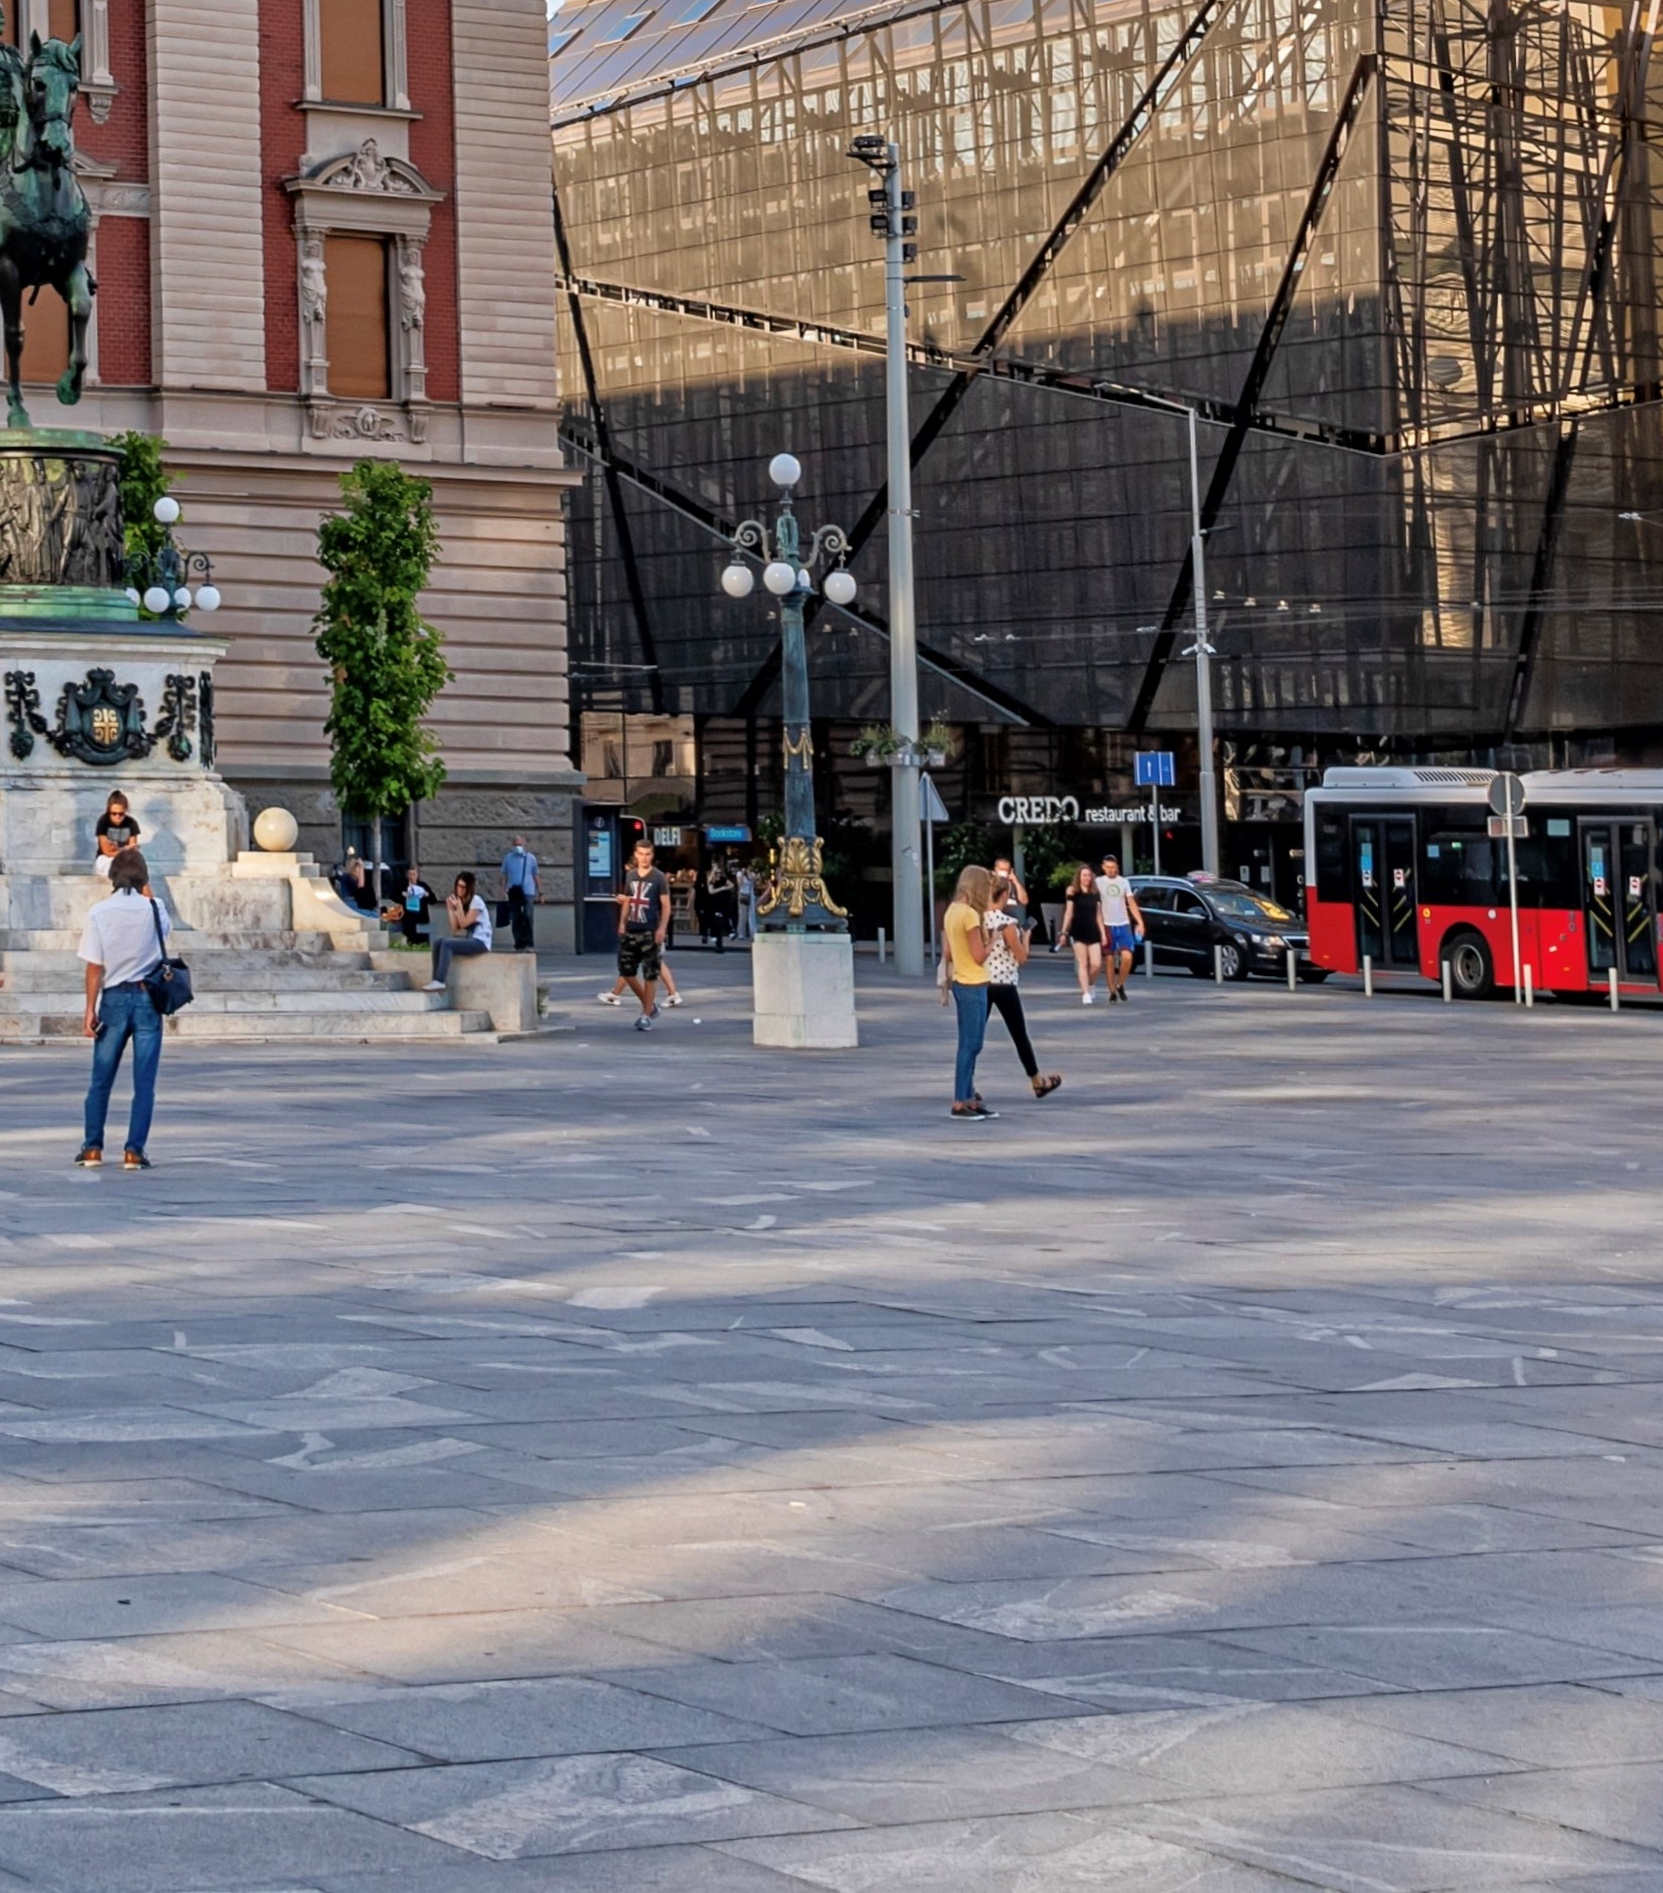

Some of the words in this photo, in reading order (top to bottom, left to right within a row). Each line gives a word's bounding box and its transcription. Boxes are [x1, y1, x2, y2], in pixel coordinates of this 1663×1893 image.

[998, 796, 1079, 824] CREDO
[1085, 806, 1146, 822] restaurant
[1160, 805, 1181, 822] bar
[654, 827, 681, 846] DELFI
